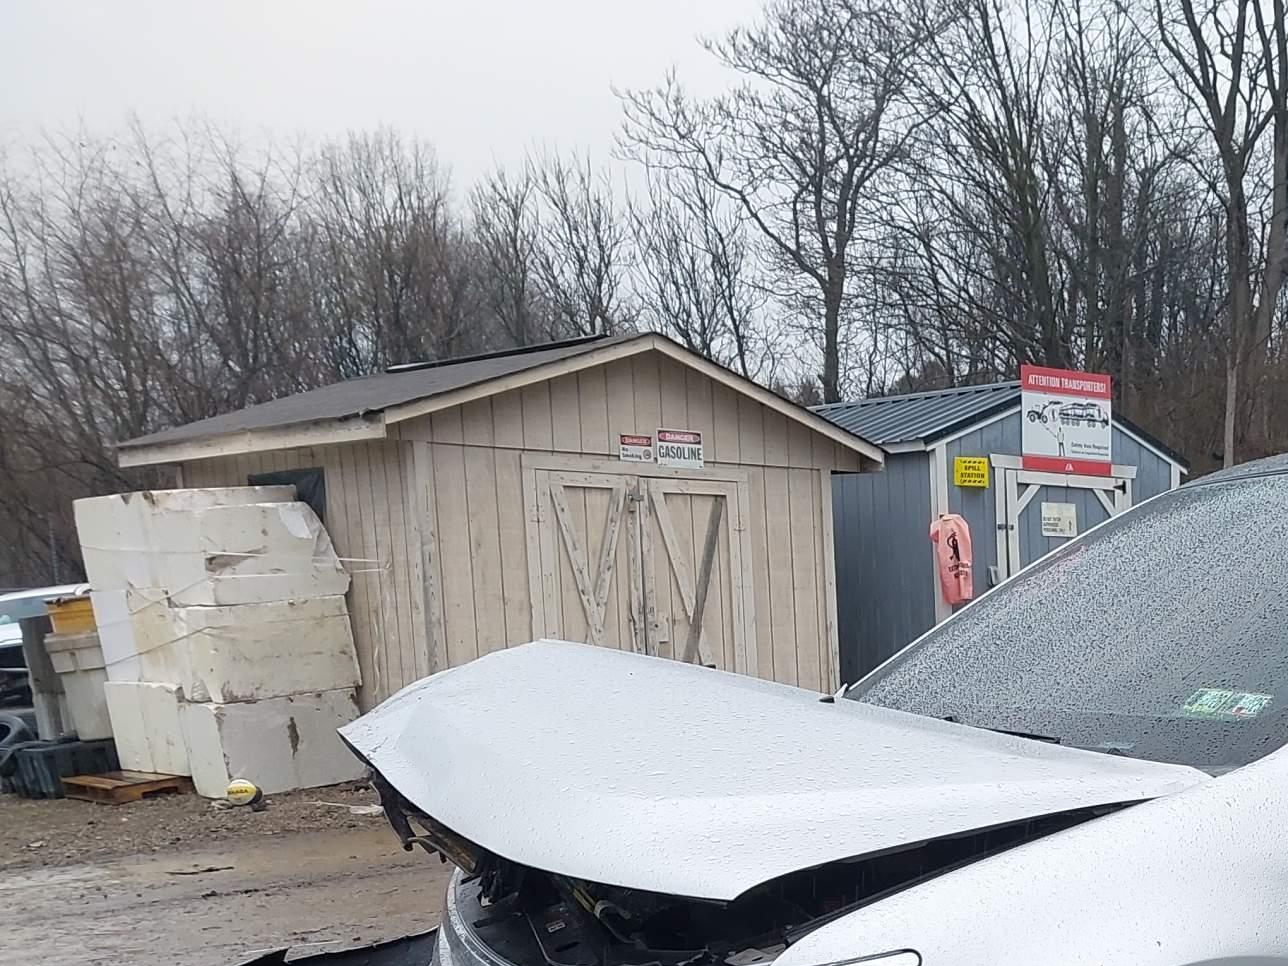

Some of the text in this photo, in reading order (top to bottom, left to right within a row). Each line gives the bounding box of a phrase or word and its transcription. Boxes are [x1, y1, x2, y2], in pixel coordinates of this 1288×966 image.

[1028, 374, 1106, 393] ATTENTION TRANSPORTERS!
[665, 432, 694, 442] DANGER
[658, 445, 703, 461] GASOLINE
